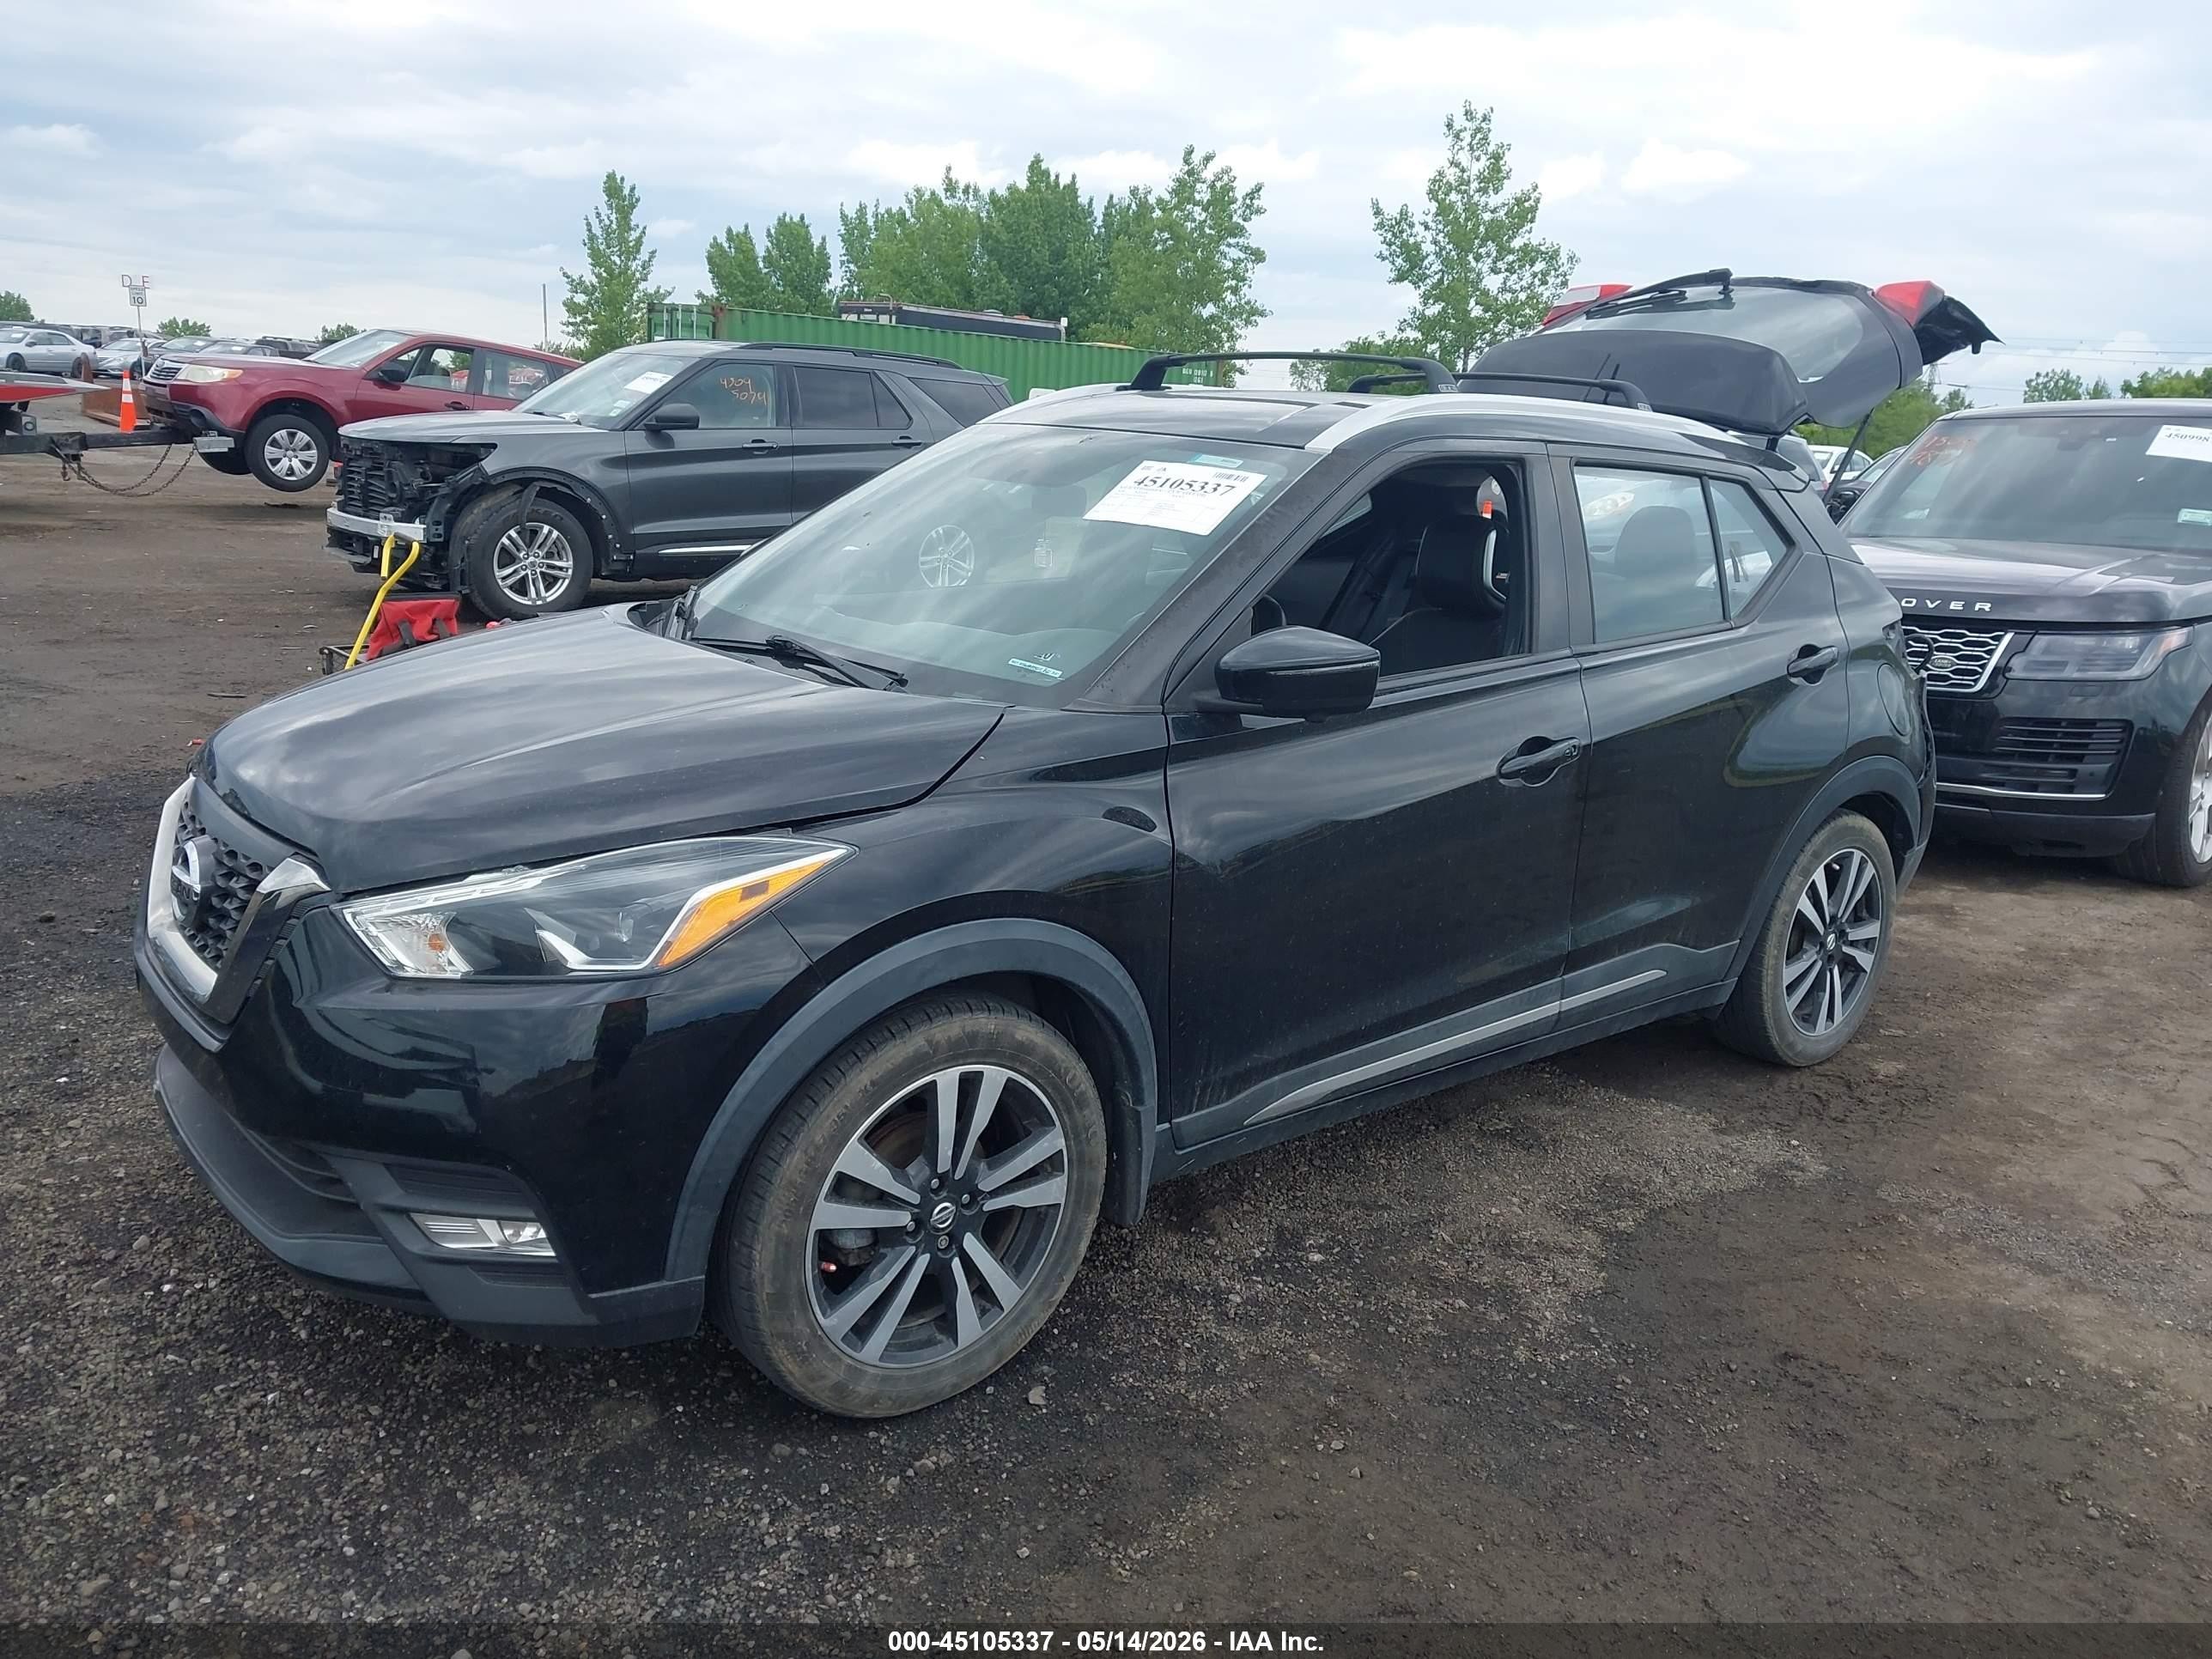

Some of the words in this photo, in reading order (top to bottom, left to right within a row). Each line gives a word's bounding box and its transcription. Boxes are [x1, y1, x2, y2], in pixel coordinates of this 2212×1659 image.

[121, 274, 132, 288] D
[142, 275, 151, 289] E
[132, 295, 144, 305] 10
[1133, 475, 1237, 496] 45105337
[1901, 599, 1991, 611] OVER
